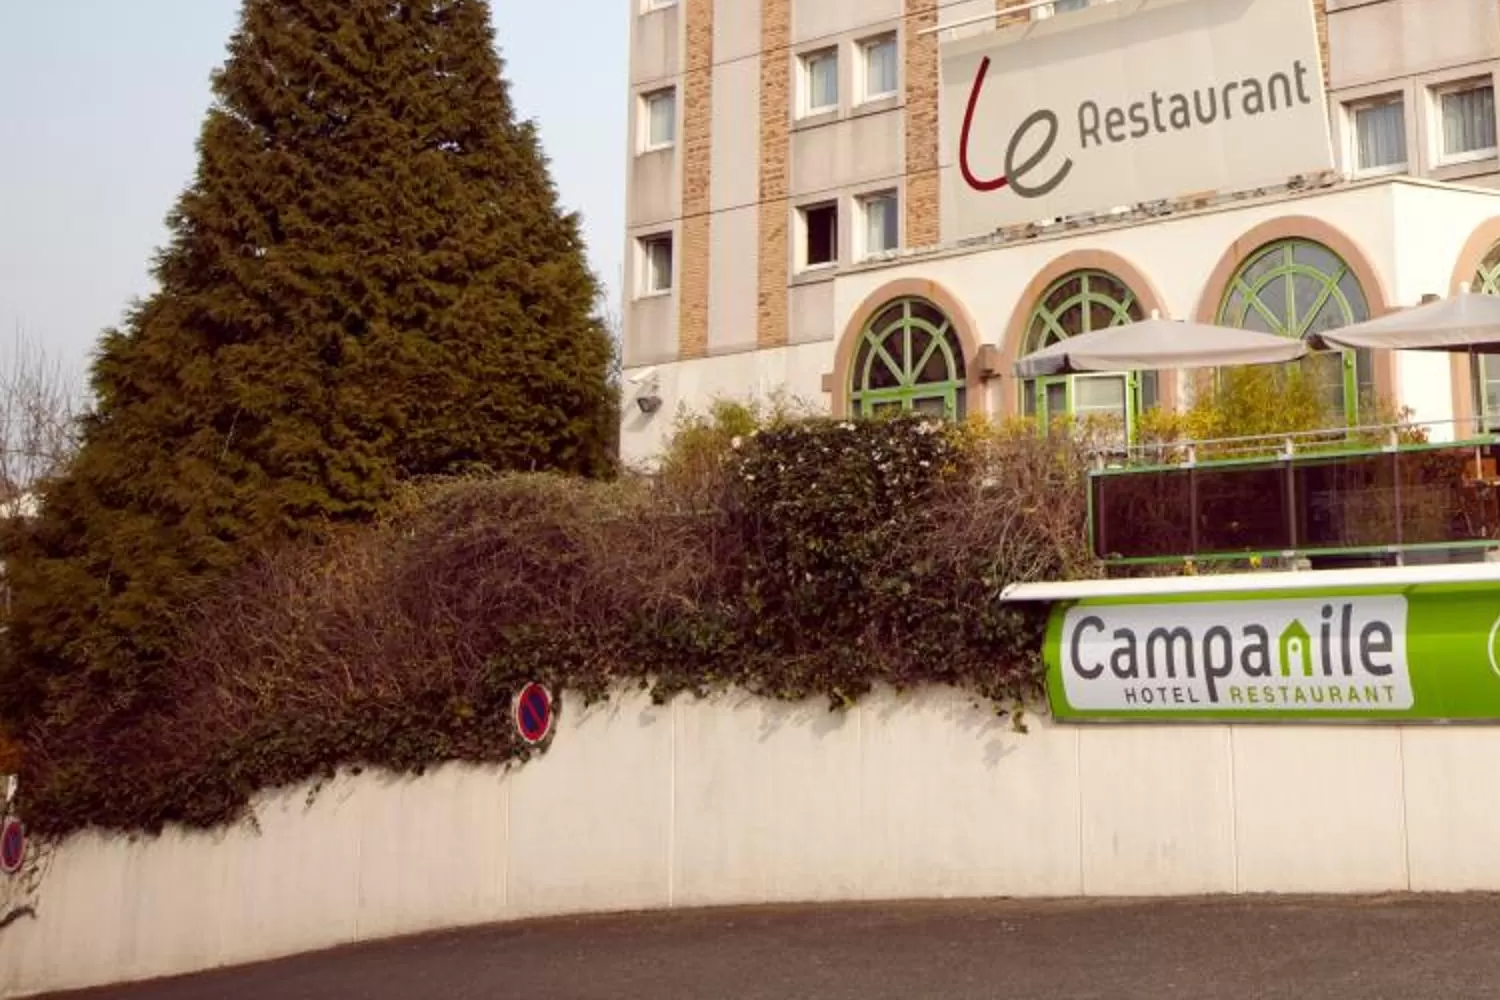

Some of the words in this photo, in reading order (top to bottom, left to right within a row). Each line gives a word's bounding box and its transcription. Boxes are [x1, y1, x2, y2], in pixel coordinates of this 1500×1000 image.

[959, 56, 1073, 198] Le
[1077, 60, 1311, 149] Restaurant
[1070, 603, 1394, 703] Campanile
[1124, 686, 1200, 704] HOTEL
[1229, 685, 1395, 704] RESTAURANT
